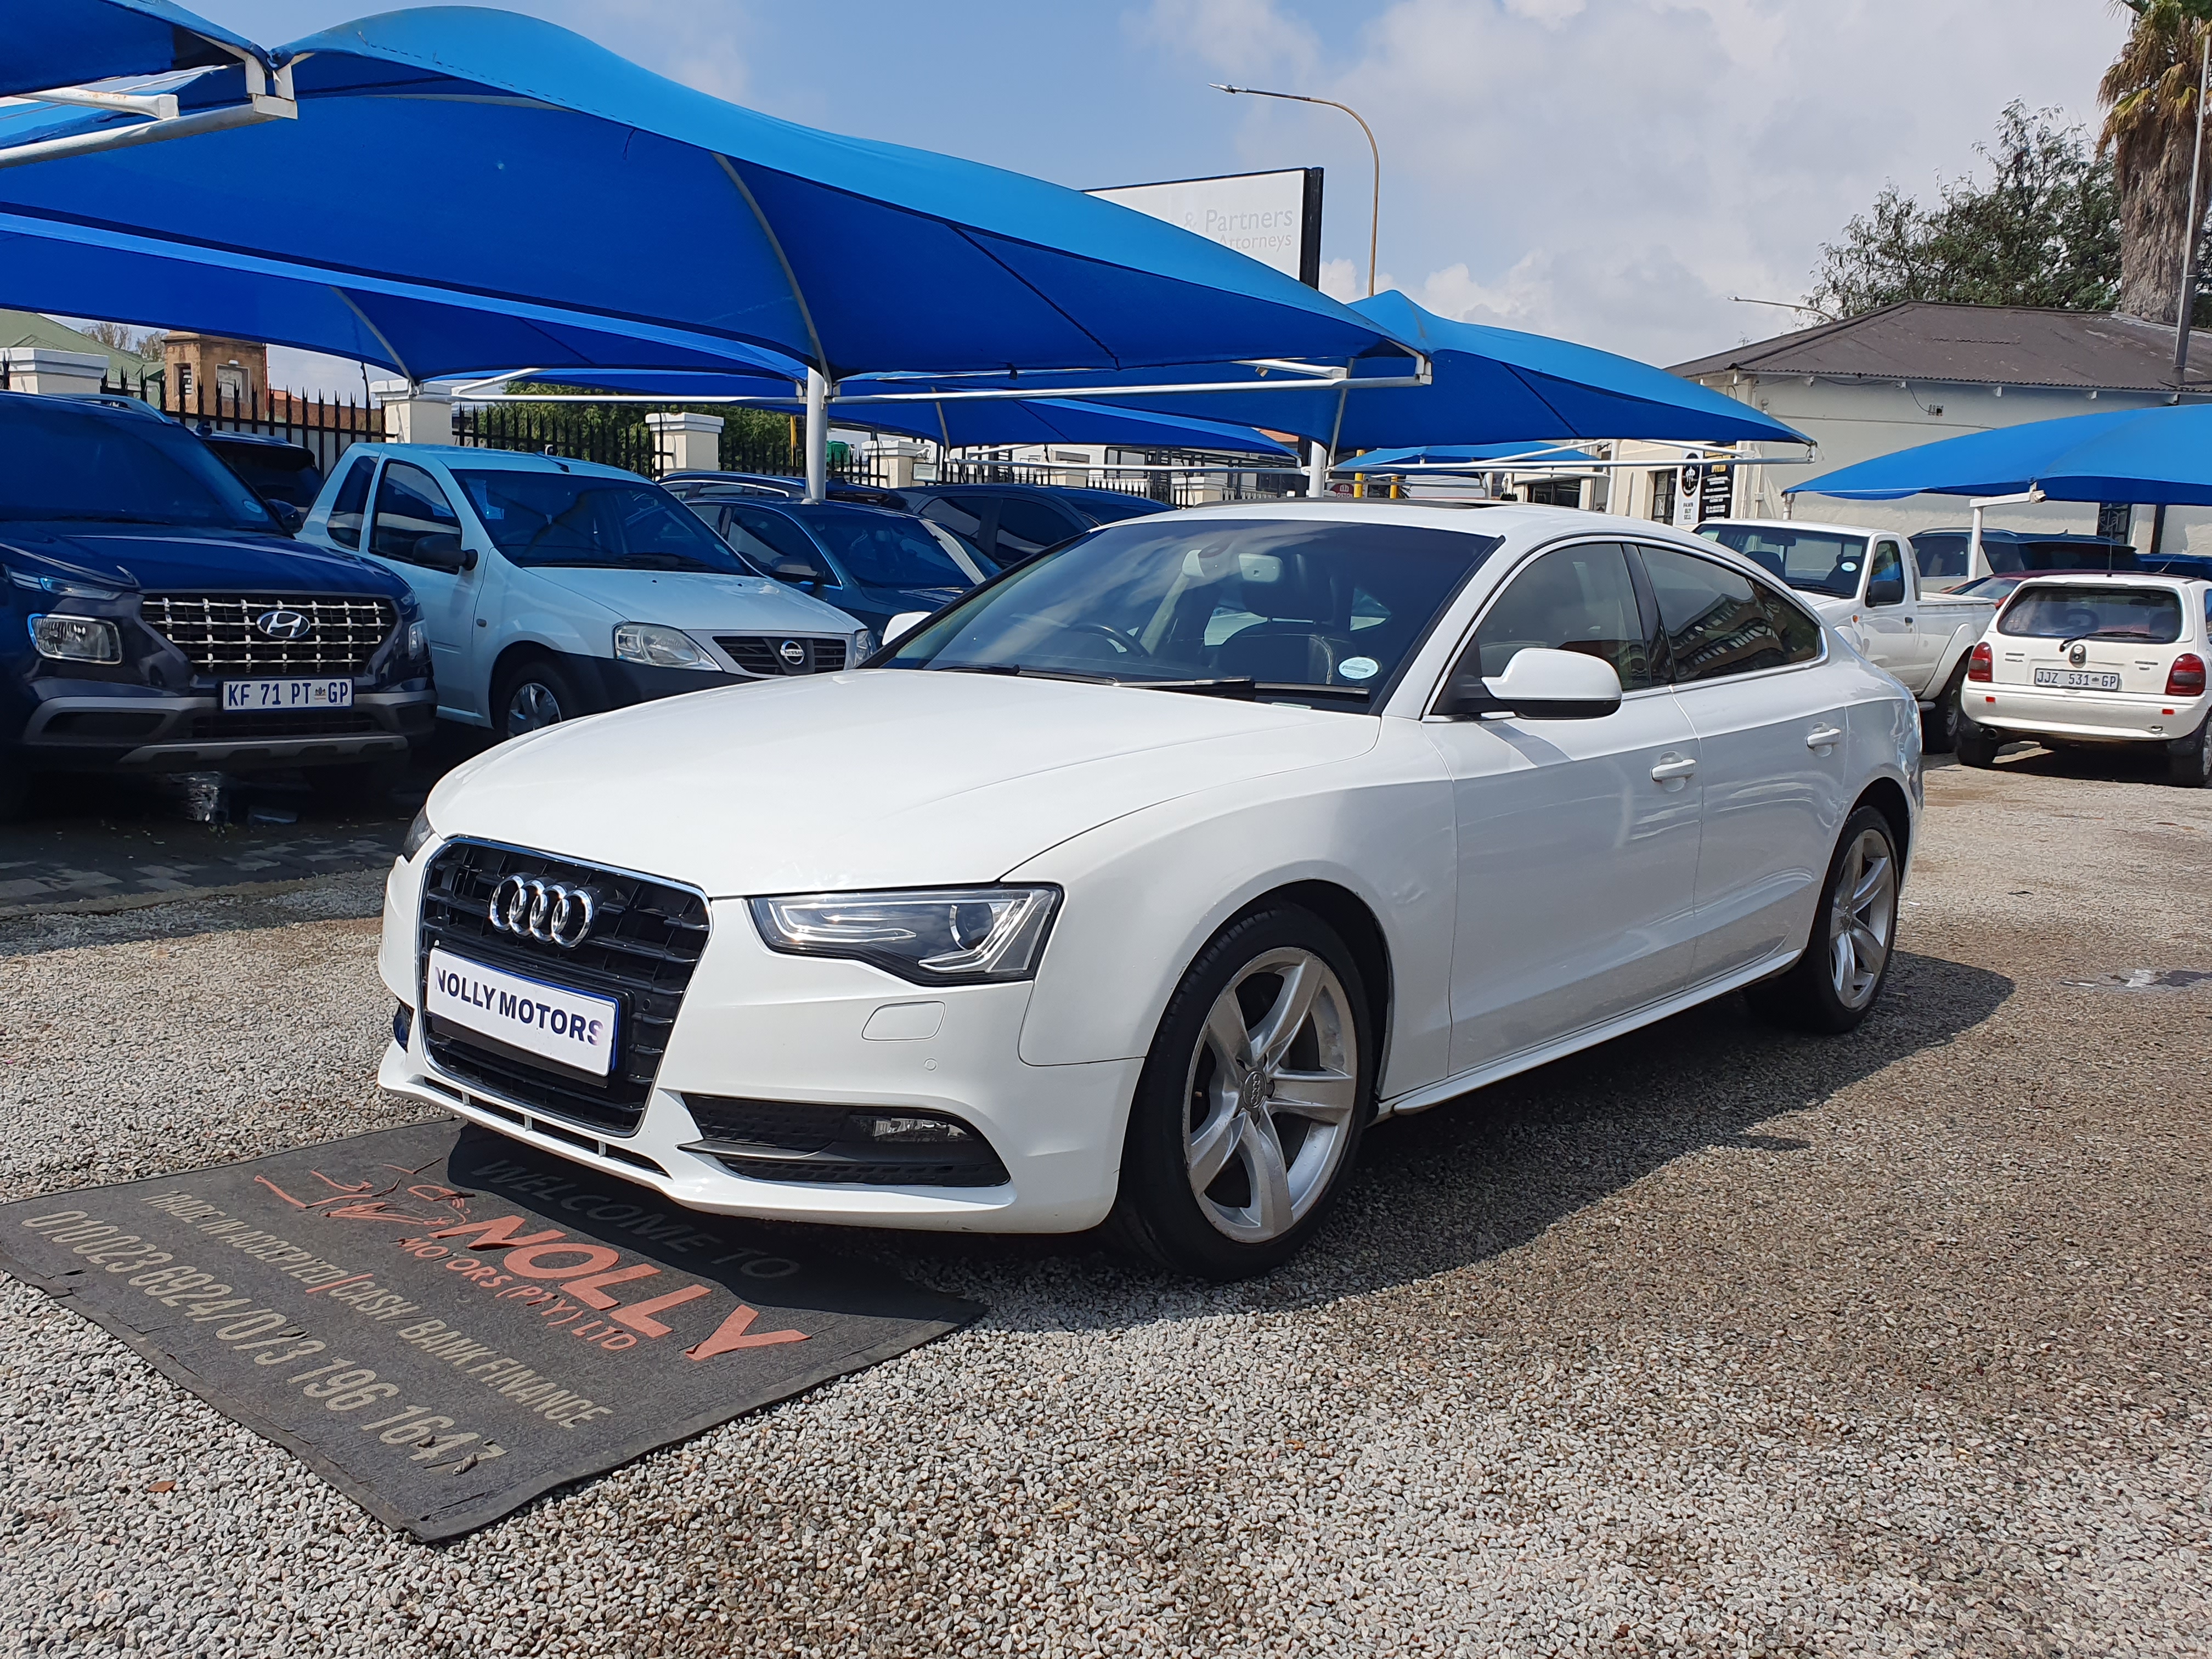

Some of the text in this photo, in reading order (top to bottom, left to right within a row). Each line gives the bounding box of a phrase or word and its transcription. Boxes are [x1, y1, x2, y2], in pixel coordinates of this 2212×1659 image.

[1205, 209, 1293, 233] Partners
[1218, 234, 1292, 252] Attorneys
[228, 682, 348, 707] KF 71 PT GP
[2036, 671, 2116, 686] JJZ 531 GP
[435, 966, 603, 1046] NOLLY MOTORS
[470, 1159, 800, 1278] WELCOME TO
[139, 1190, 227, 1223] TRADE
[196, 1218, 251, 1235] IN
[465, 1356, 613, 1428] FINANCE
[428, 1215, 812, 1361] NOLLY
[495, 1285, 584, 1327] (PTY)
[571, 1319, 637, 1350] LTD
[286, 1357, 400, 1412] 196
[359, 1404, 510, 1476] 1647
